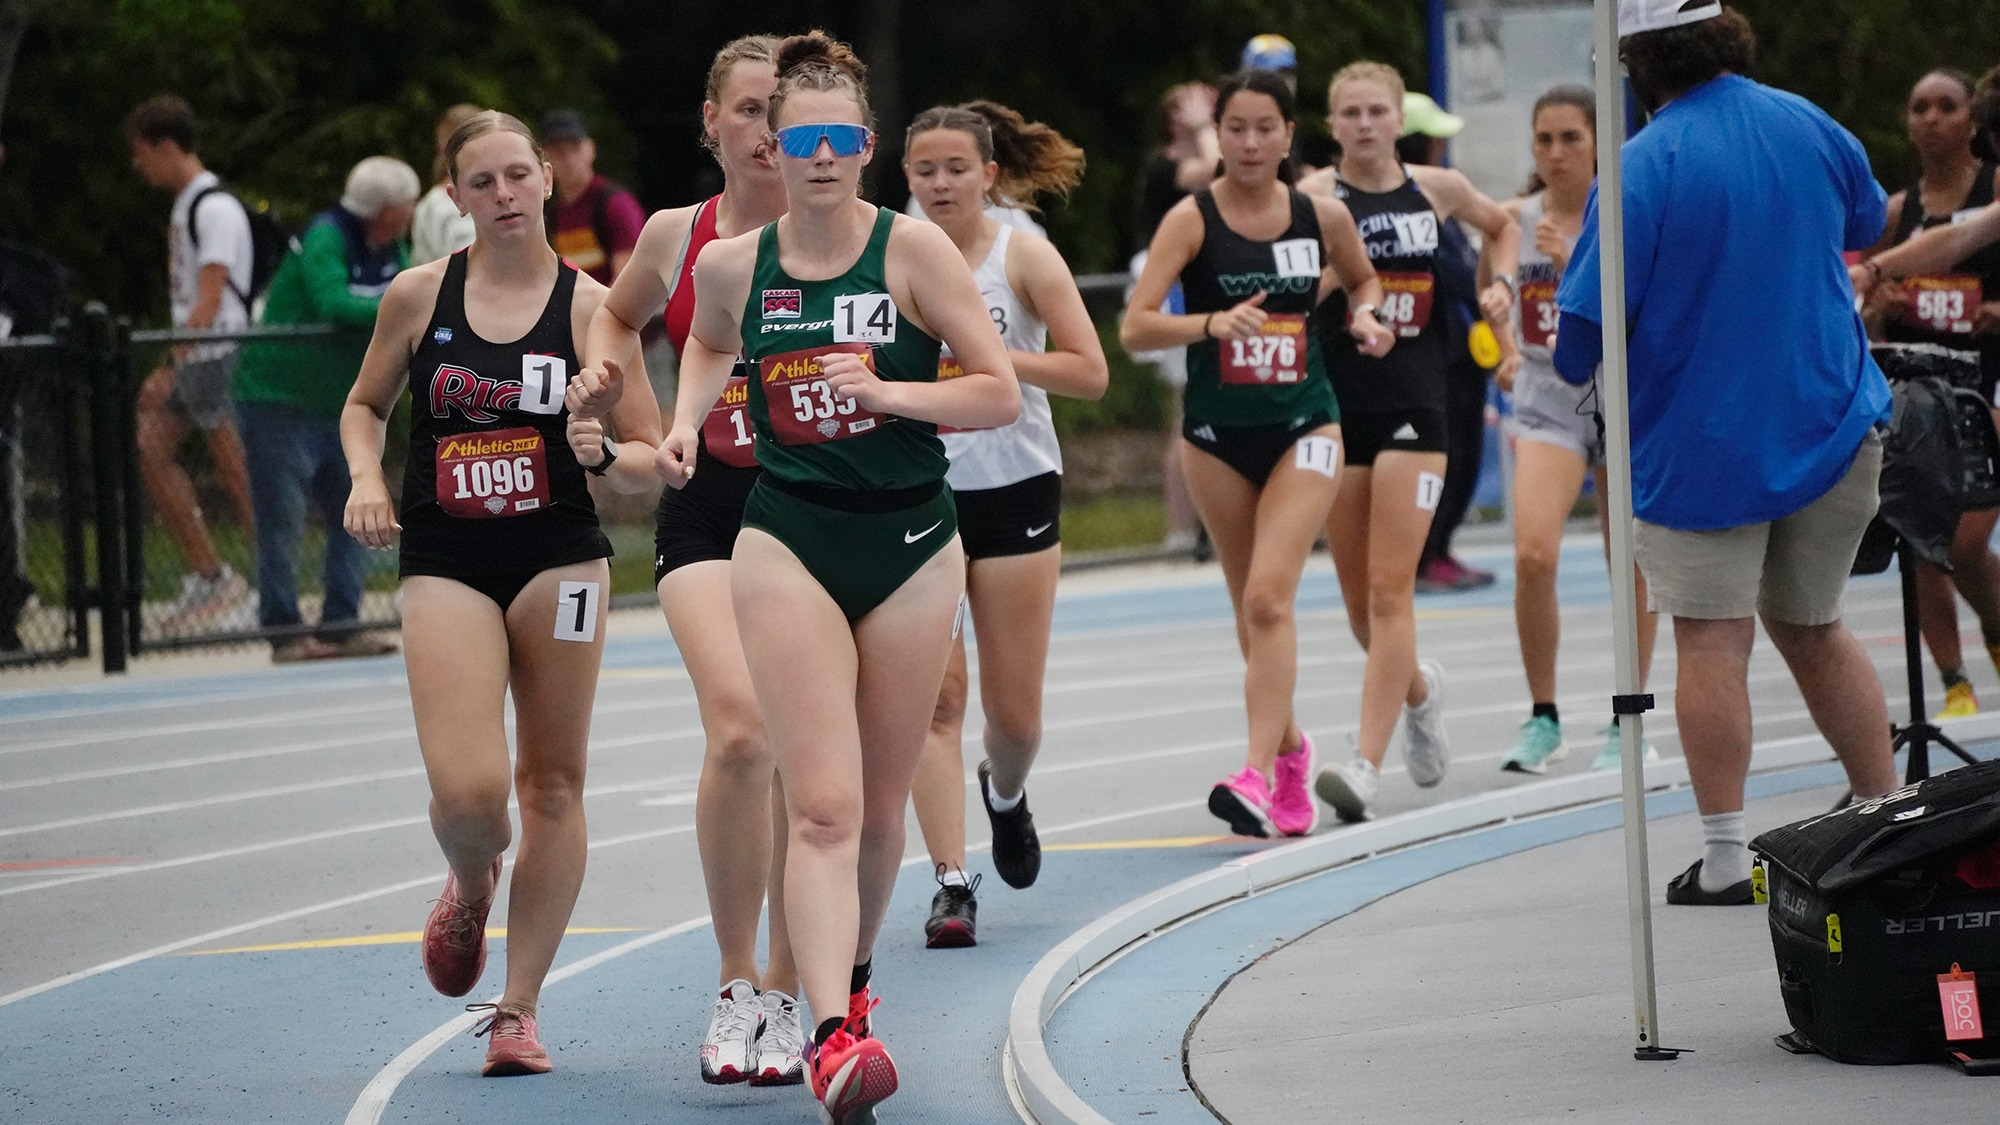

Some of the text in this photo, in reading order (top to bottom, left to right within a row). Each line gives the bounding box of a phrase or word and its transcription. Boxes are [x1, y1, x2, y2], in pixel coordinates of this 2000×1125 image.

[1404, 216, 1437, 247] 12
[1281, 245, 1314, 271] 11
[1218, 272, 1313, 296] WWU
[764, 298, 800, 310] CCC
[840, 299, 893, 336] 14
[1380, 291, 1416, 324] 48
[1917, 290, 1964, 320] 583
[1231, 335, 1297, 367] 1376
[532, 362, 552, 405] 1
[766, 357, 824, 382] Athle
[730, 409, 757, 447] 1
[440, 438, 513, 460] Athletic
[1302, 441, 1333, 470] 11
[452, 456, 535, 499] 1096
[568, 588, 587, 632] 1
[1776, 888, 1808, 918] ELLER
[1885, 910, 2000, 934] UELLER
